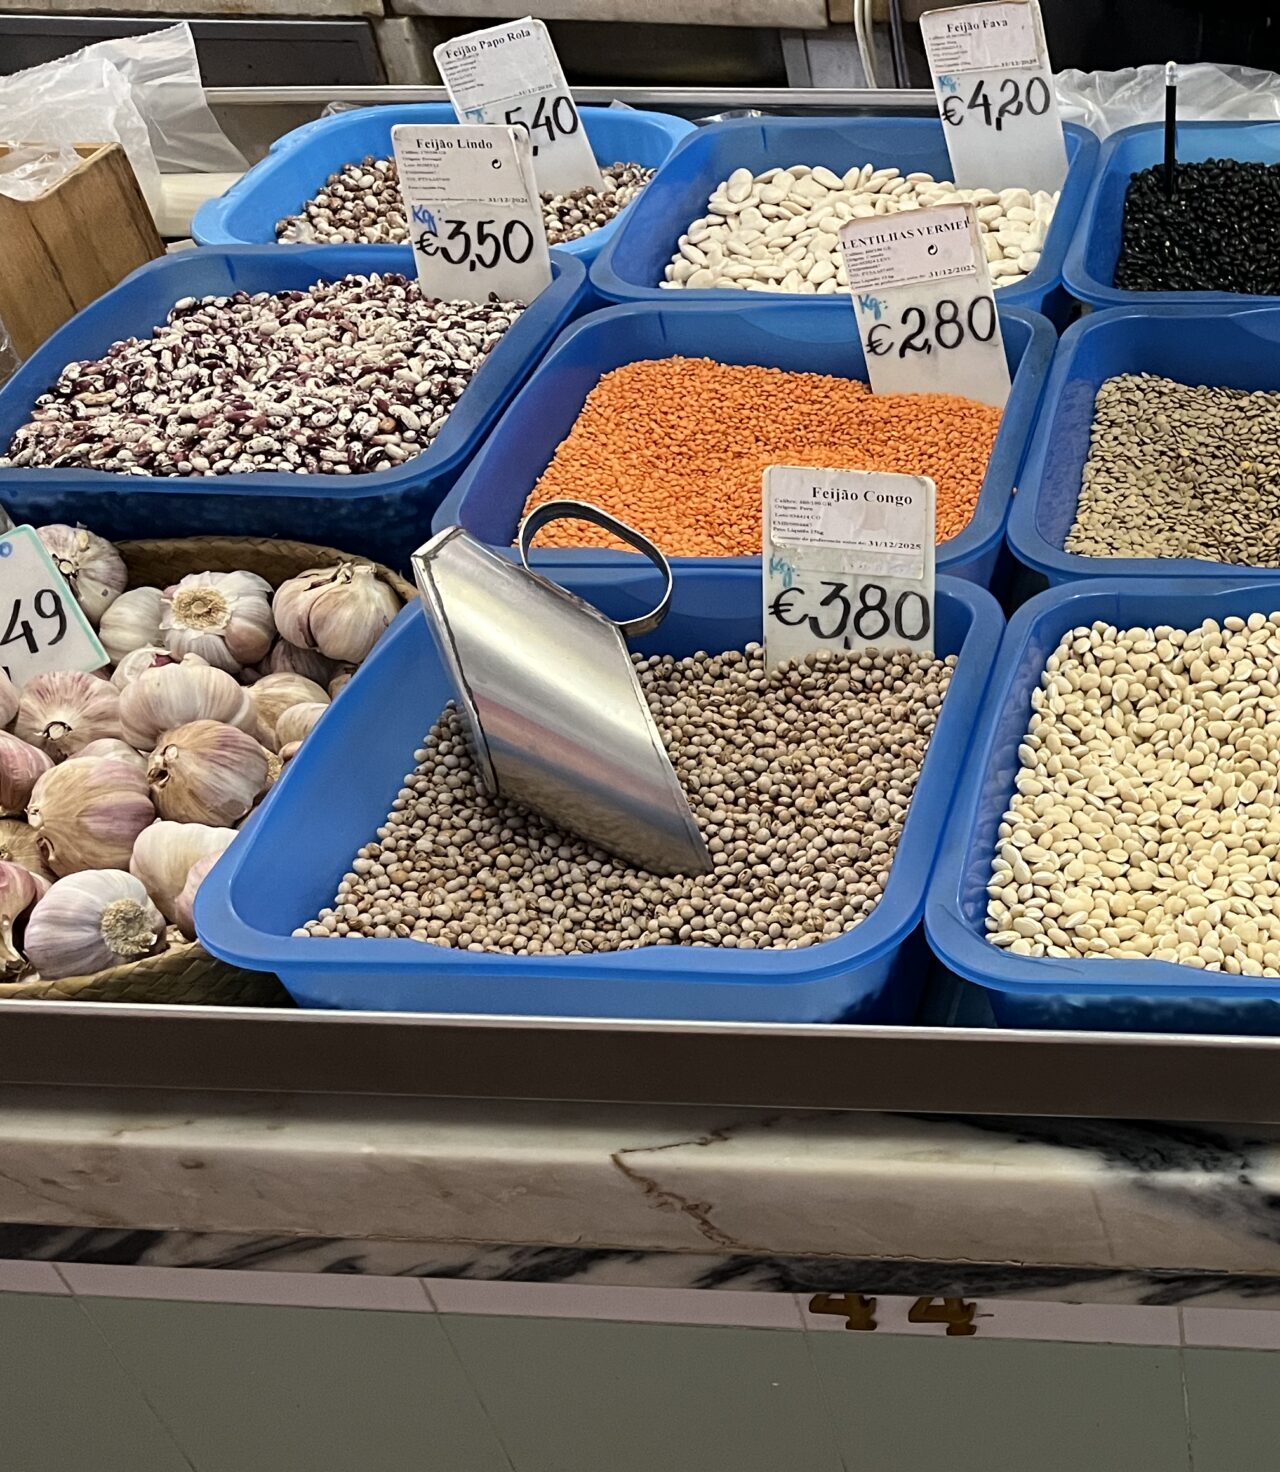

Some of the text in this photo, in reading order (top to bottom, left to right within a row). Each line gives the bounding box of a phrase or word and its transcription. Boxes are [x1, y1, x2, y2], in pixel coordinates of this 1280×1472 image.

[445, 29, 531, 59] Feijão Papo Rola
[947, 19, 1008, 33] Feijão Fava
[942, 76, 1051, 131] €4,20
[416, 139, 493, 150] Feijão Lindo
[485, 96, 578, 156] 5,40
[414, 219, 534, 272] €3,50
[842, 229, 915, 250] LENTILHAS
[866, 296, 996, 359] €2,80
[812, 487, 912, 507] Feijão Congo
[768, 581, 930, 650] €3,80
